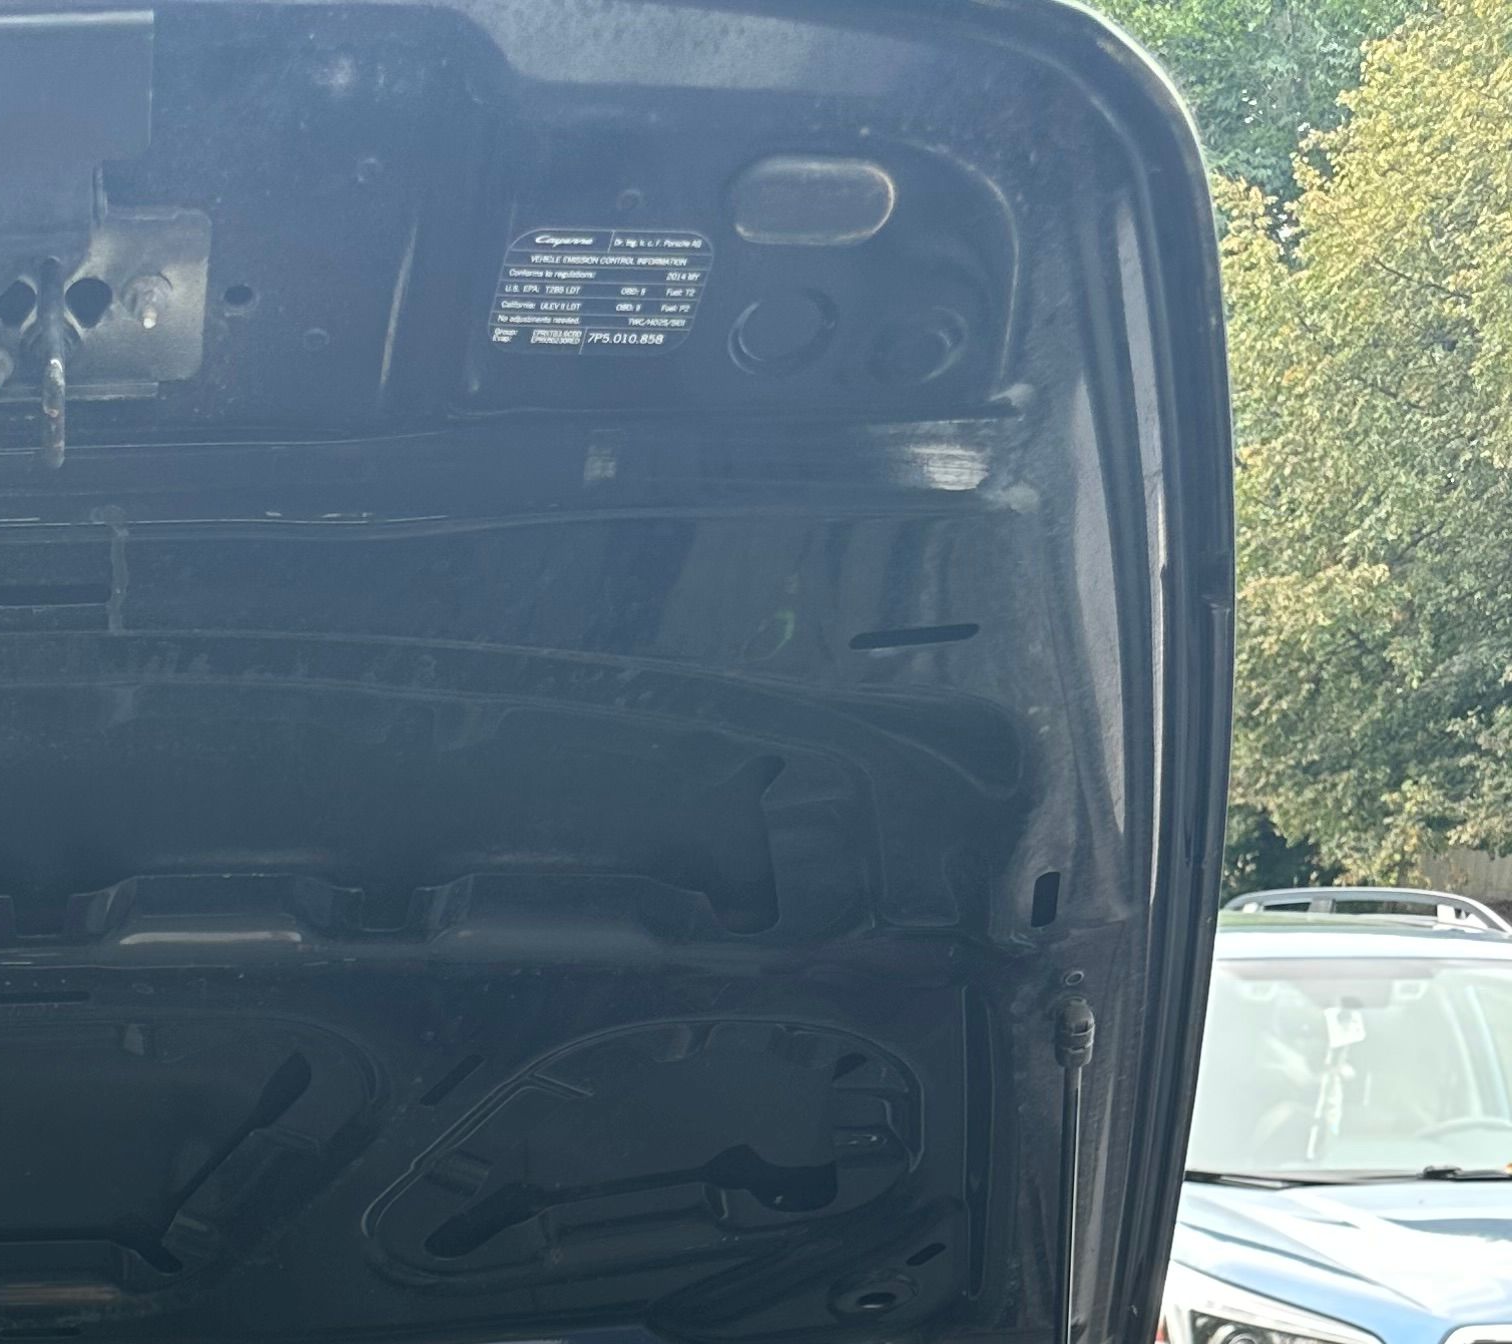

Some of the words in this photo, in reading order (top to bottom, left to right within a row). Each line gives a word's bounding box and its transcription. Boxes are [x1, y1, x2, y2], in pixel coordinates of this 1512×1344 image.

[531, 255, 561, 264] VEHICLE
[562, 256, 598, 265] EMISSION
[600, 256, 635, 266] CONTROL
[637, 257, 687, 267] INFORMATION
[666, 273, 686, 281] 2014
[587, 332, 664, 345] 7P5.010.858
